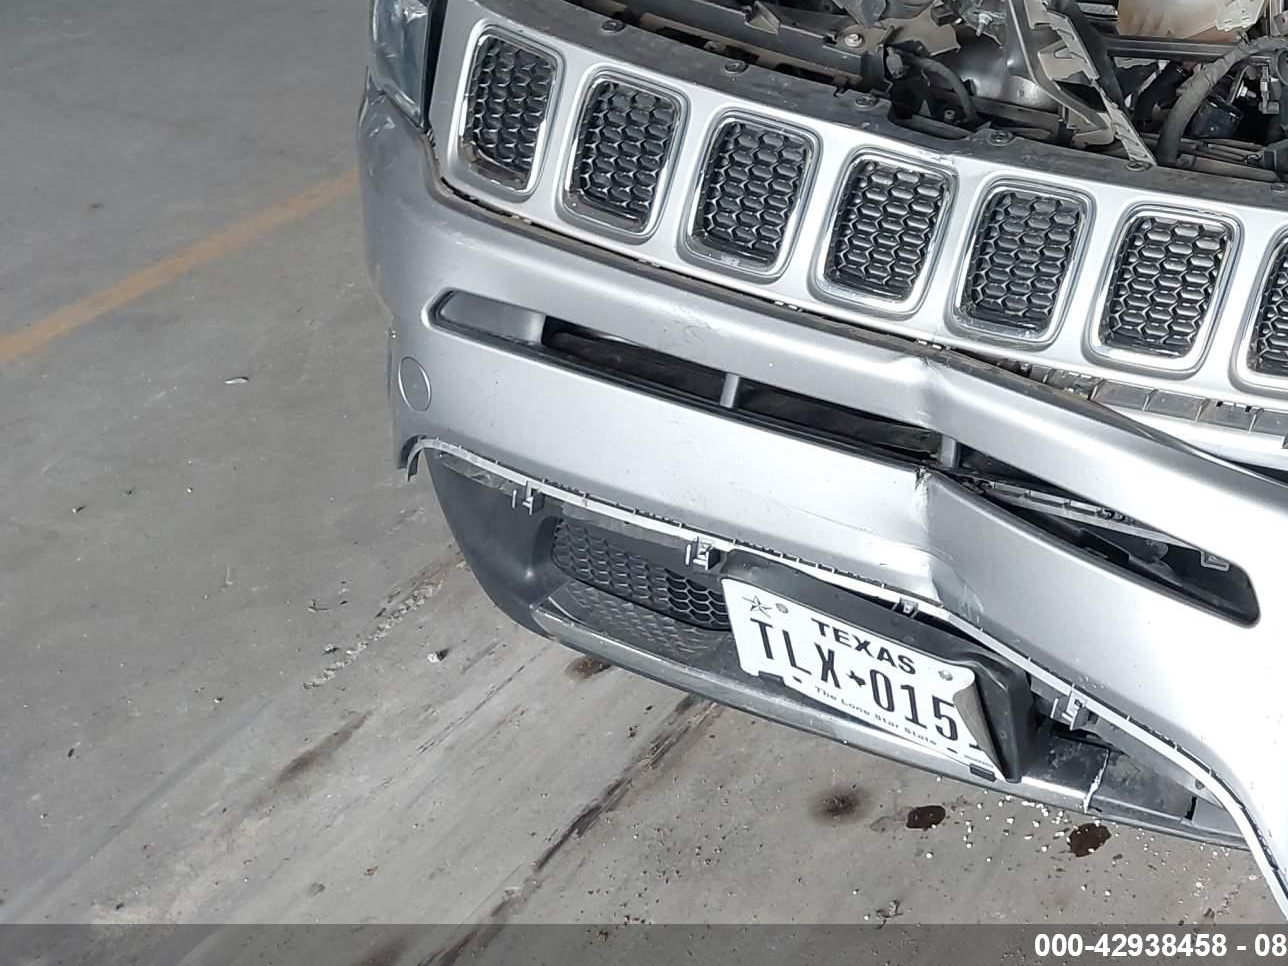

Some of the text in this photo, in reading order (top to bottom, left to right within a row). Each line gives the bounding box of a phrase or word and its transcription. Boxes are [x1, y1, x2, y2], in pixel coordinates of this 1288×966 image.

[810, 617, 915, 675] TEXAS
[815, 686, 937, 746] The Lone Star State
